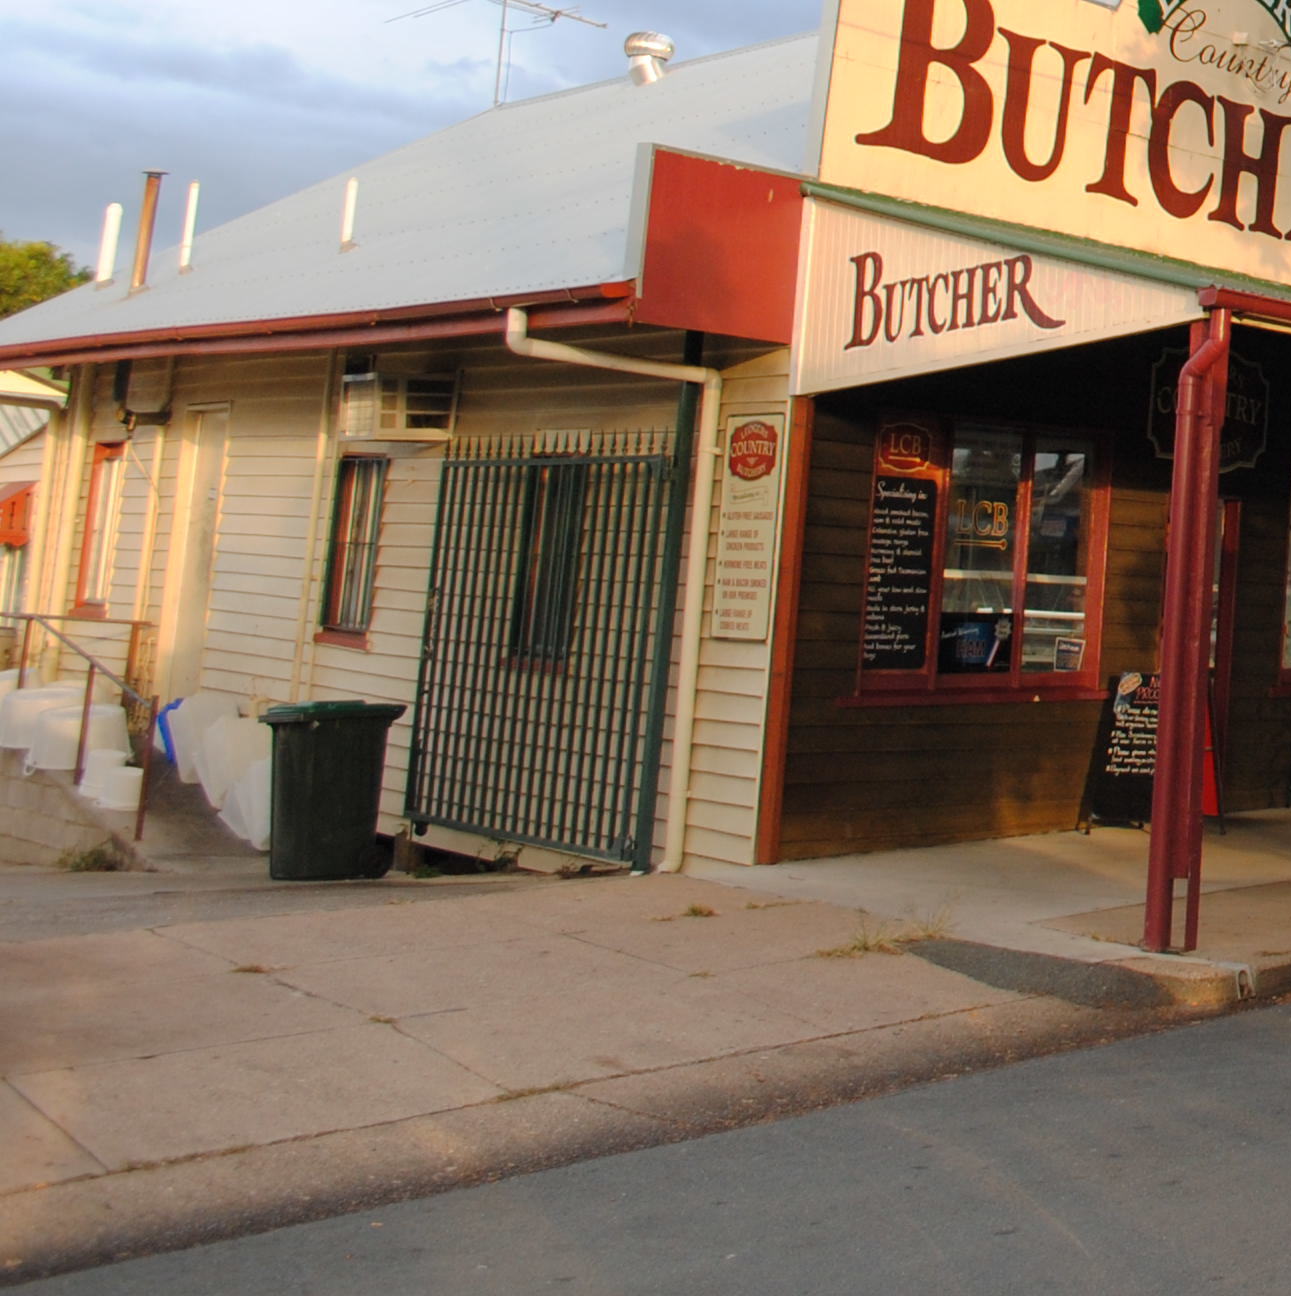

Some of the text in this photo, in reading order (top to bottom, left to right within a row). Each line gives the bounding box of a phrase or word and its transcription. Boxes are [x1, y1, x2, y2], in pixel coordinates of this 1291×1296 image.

[844, 252, 1067, 351] BUTCHER
[731, 439, 776, 458] COUNTRY
[890, 433, 922, 455] LCB
[956, 499, 1009, 538] LCB
